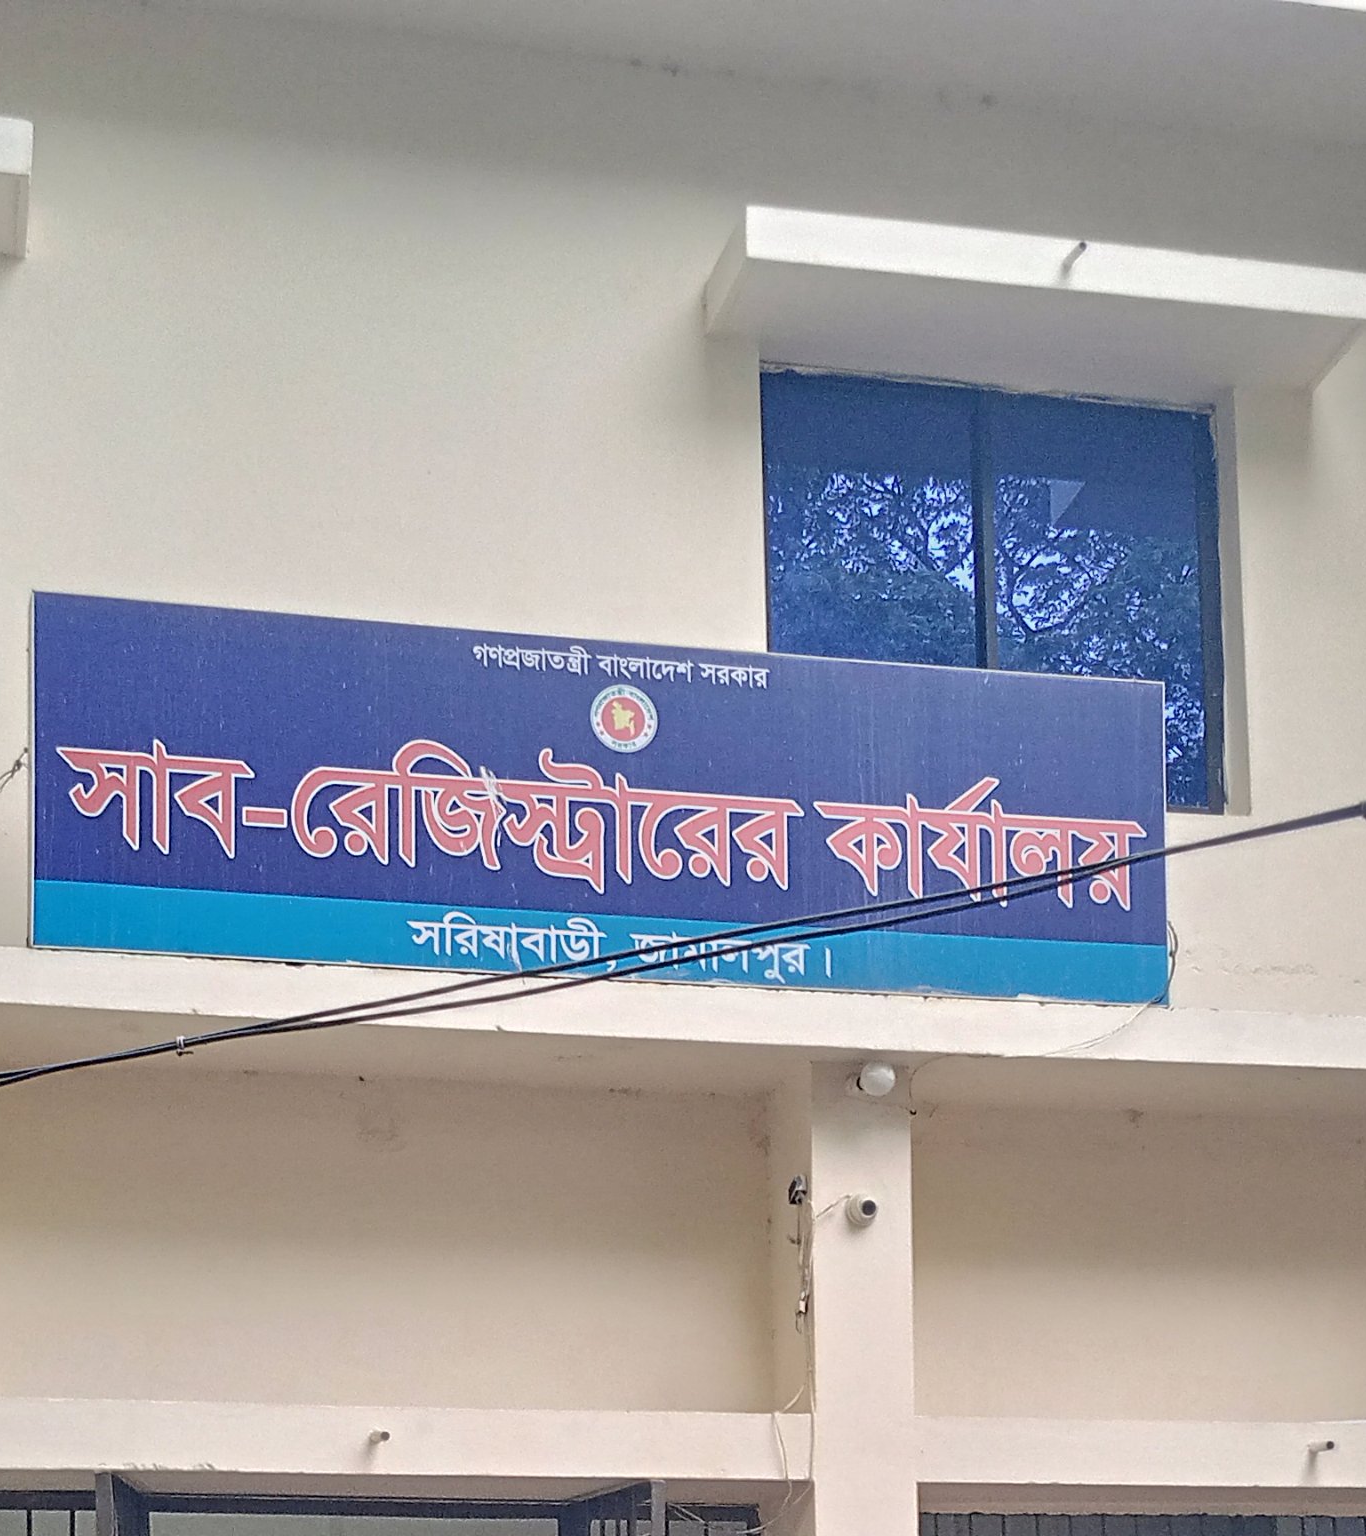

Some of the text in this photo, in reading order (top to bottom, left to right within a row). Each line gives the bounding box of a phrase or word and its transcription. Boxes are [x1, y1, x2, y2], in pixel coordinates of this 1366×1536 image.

[472, 643, 770, 689] গণপ্রজাতন্ত্রী বাংলাদেশ সরকার
[55, 738, 1148, 912] সাব-রেজিস্ট্রারের কার্যালয়
